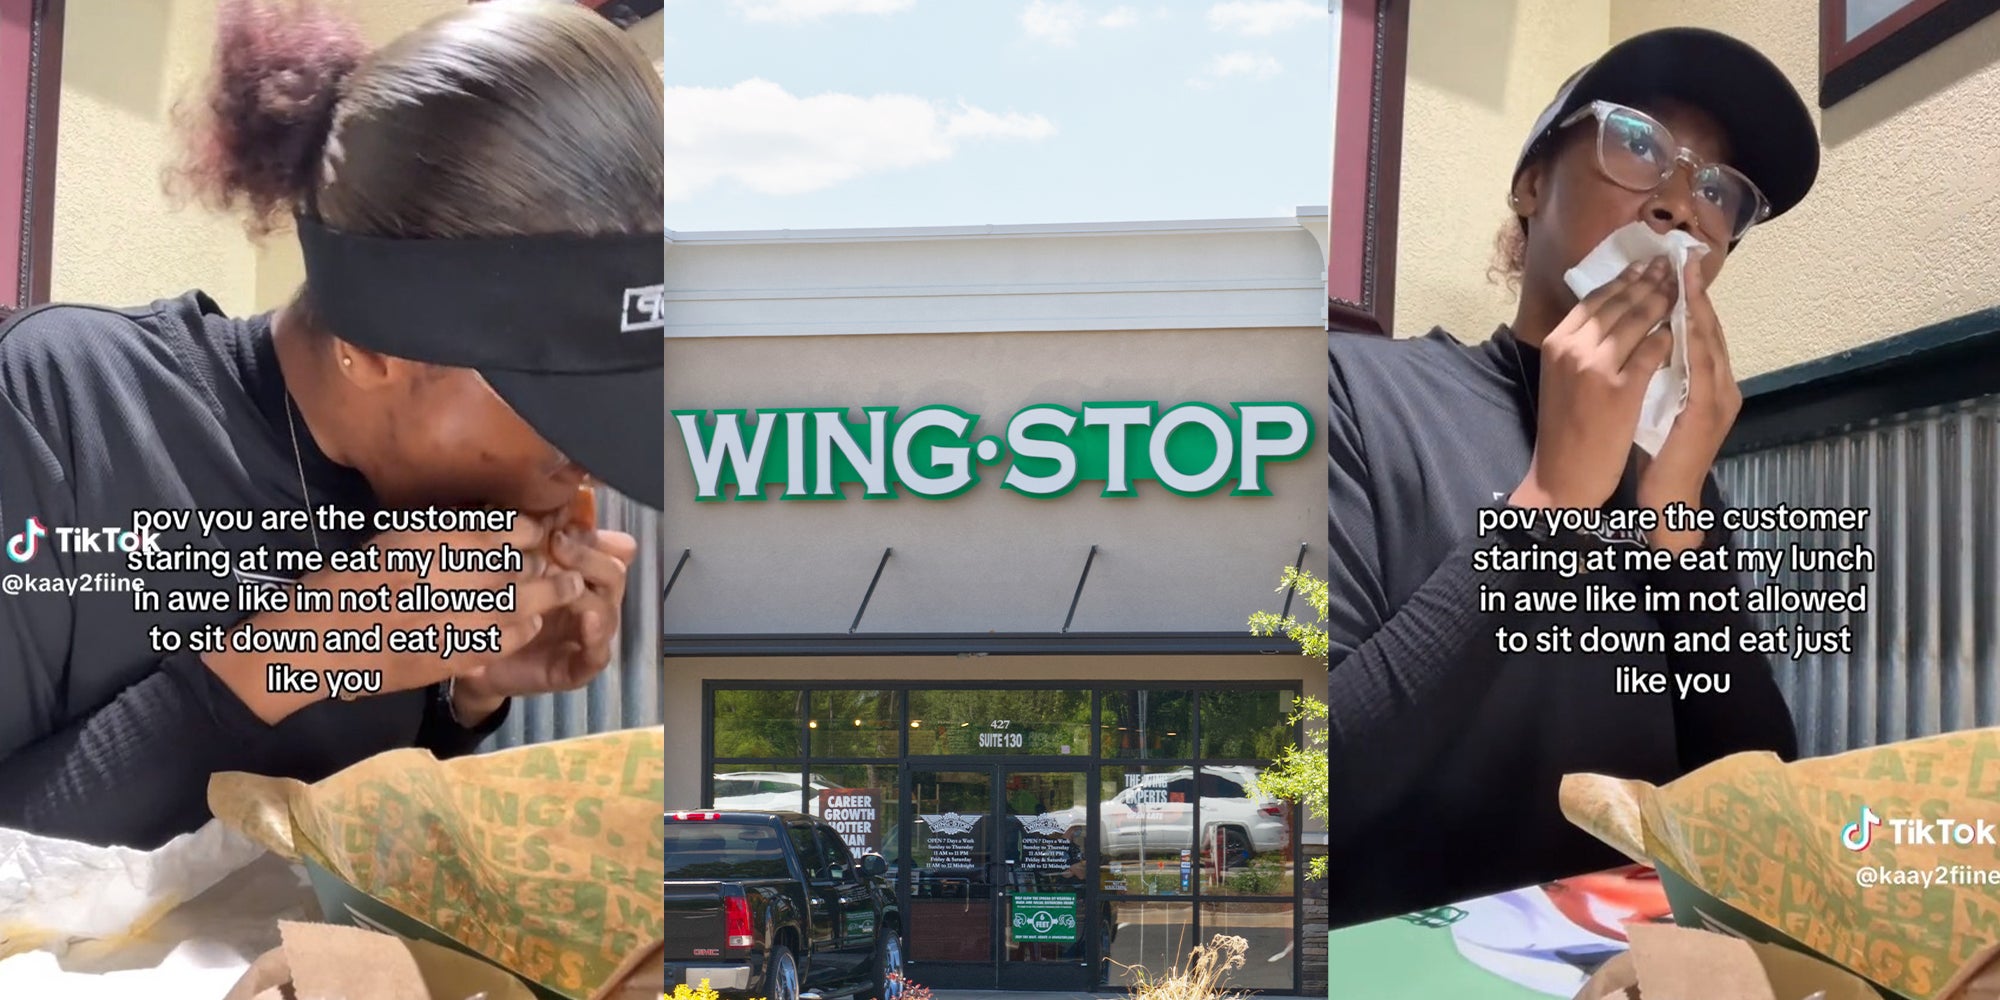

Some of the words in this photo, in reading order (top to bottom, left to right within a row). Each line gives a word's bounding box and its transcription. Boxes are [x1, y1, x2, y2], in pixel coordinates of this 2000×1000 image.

[990, 719, 1011, 730] 427
[979, 732, 1003, 748] SUITE
[1004, 732, 1023, 748] 130
[1124, 773, 1141, 788] THE
[827, 795, 872, 808] CAREER
[1125, 789, 1168, 804] EXPERTS
[824, 808, 876, 821] GROWTH
[841, 834, 866, 847] HAN
[1040, 913, 1045, 921] 6
[693, 948, 720, 956] GMC
